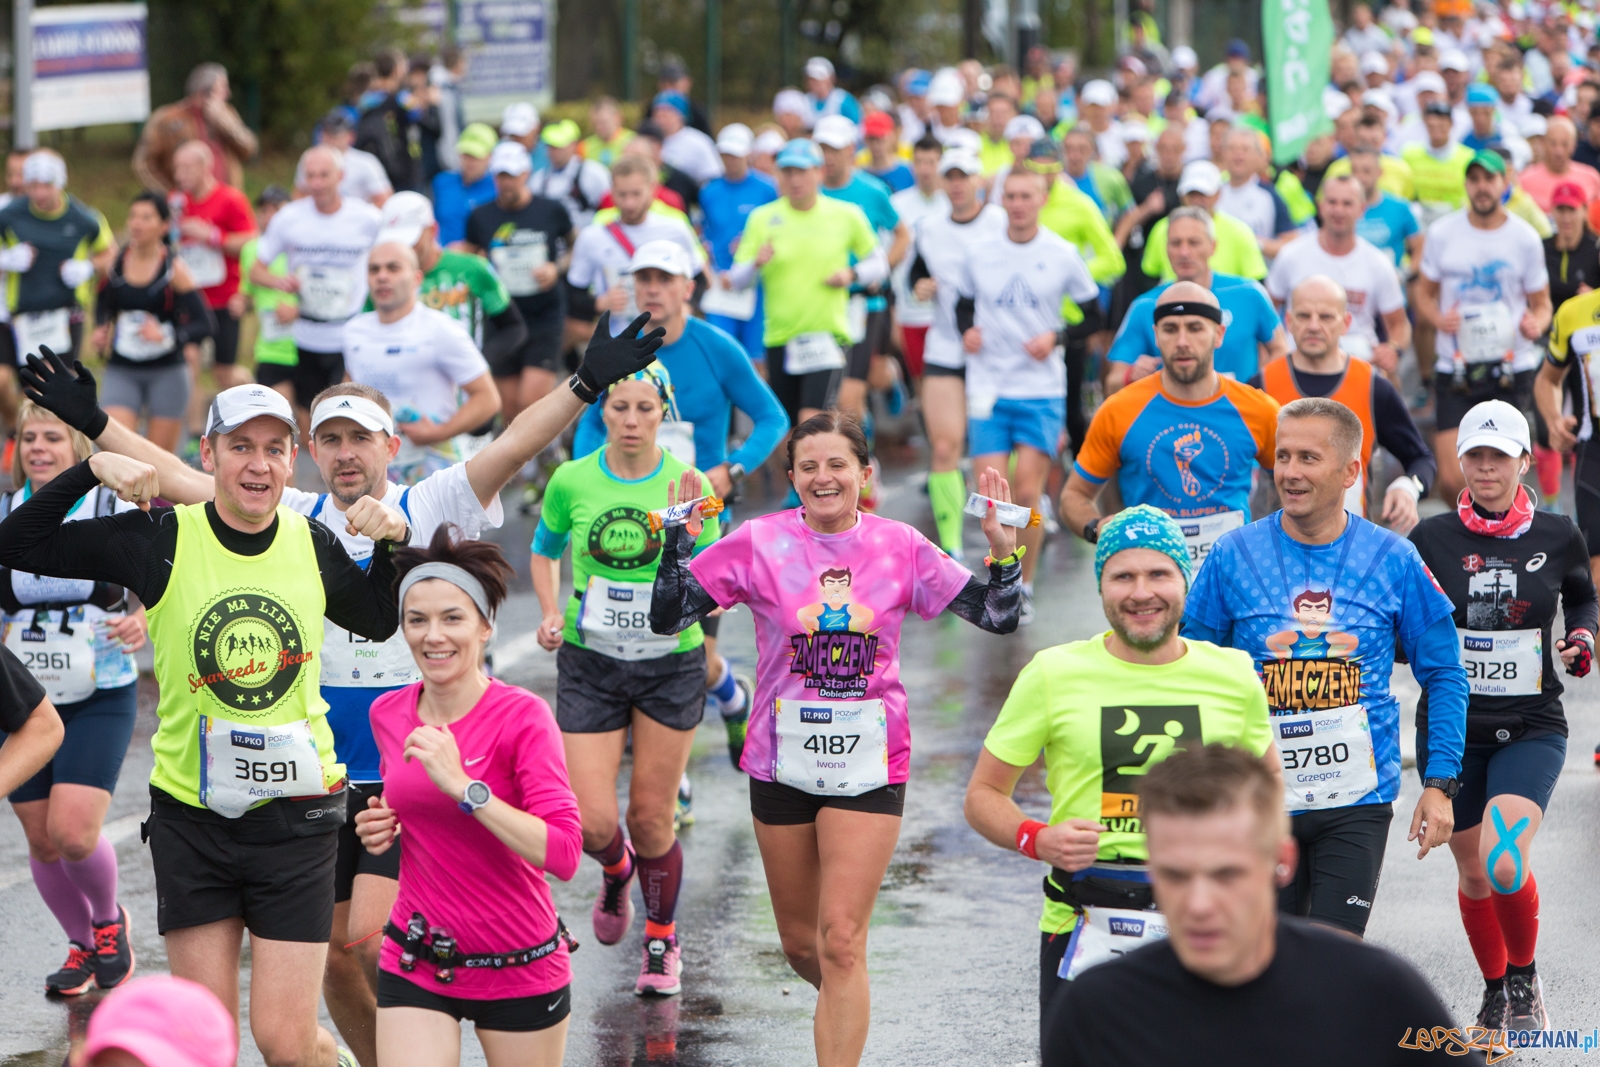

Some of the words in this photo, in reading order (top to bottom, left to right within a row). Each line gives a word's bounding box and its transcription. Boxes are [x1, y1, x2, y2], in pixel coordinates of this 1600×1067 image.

[199, 611, 222, 642] NIE
[226, 599, 250, 613] MA
[258, 601, 293, 633] LIPY
[602, 608, 651, 629] 368
[23, 652, 71, 670] 2961
[277, 649, 313, 671] Team
[355, 649, 379, 658] Piotr
[1465, 660, 1517, 680] 3128
[806, 677, 822, 687] na
[825, 676, 867, 689] starcie
[1474, 683, 1507, 693] Natalia
[820, 689, 864, 699] Dobiegniew
[803, 734, 861, 755] 4187
[816, 760, 846, 769] Iwona
[1282, 742, 1349, 769] 3780
[235, 757, 297, 783] 3691
[1296, 770, 1341, 783] Grzegorz
[248, 787, 283, 797] Adrian
